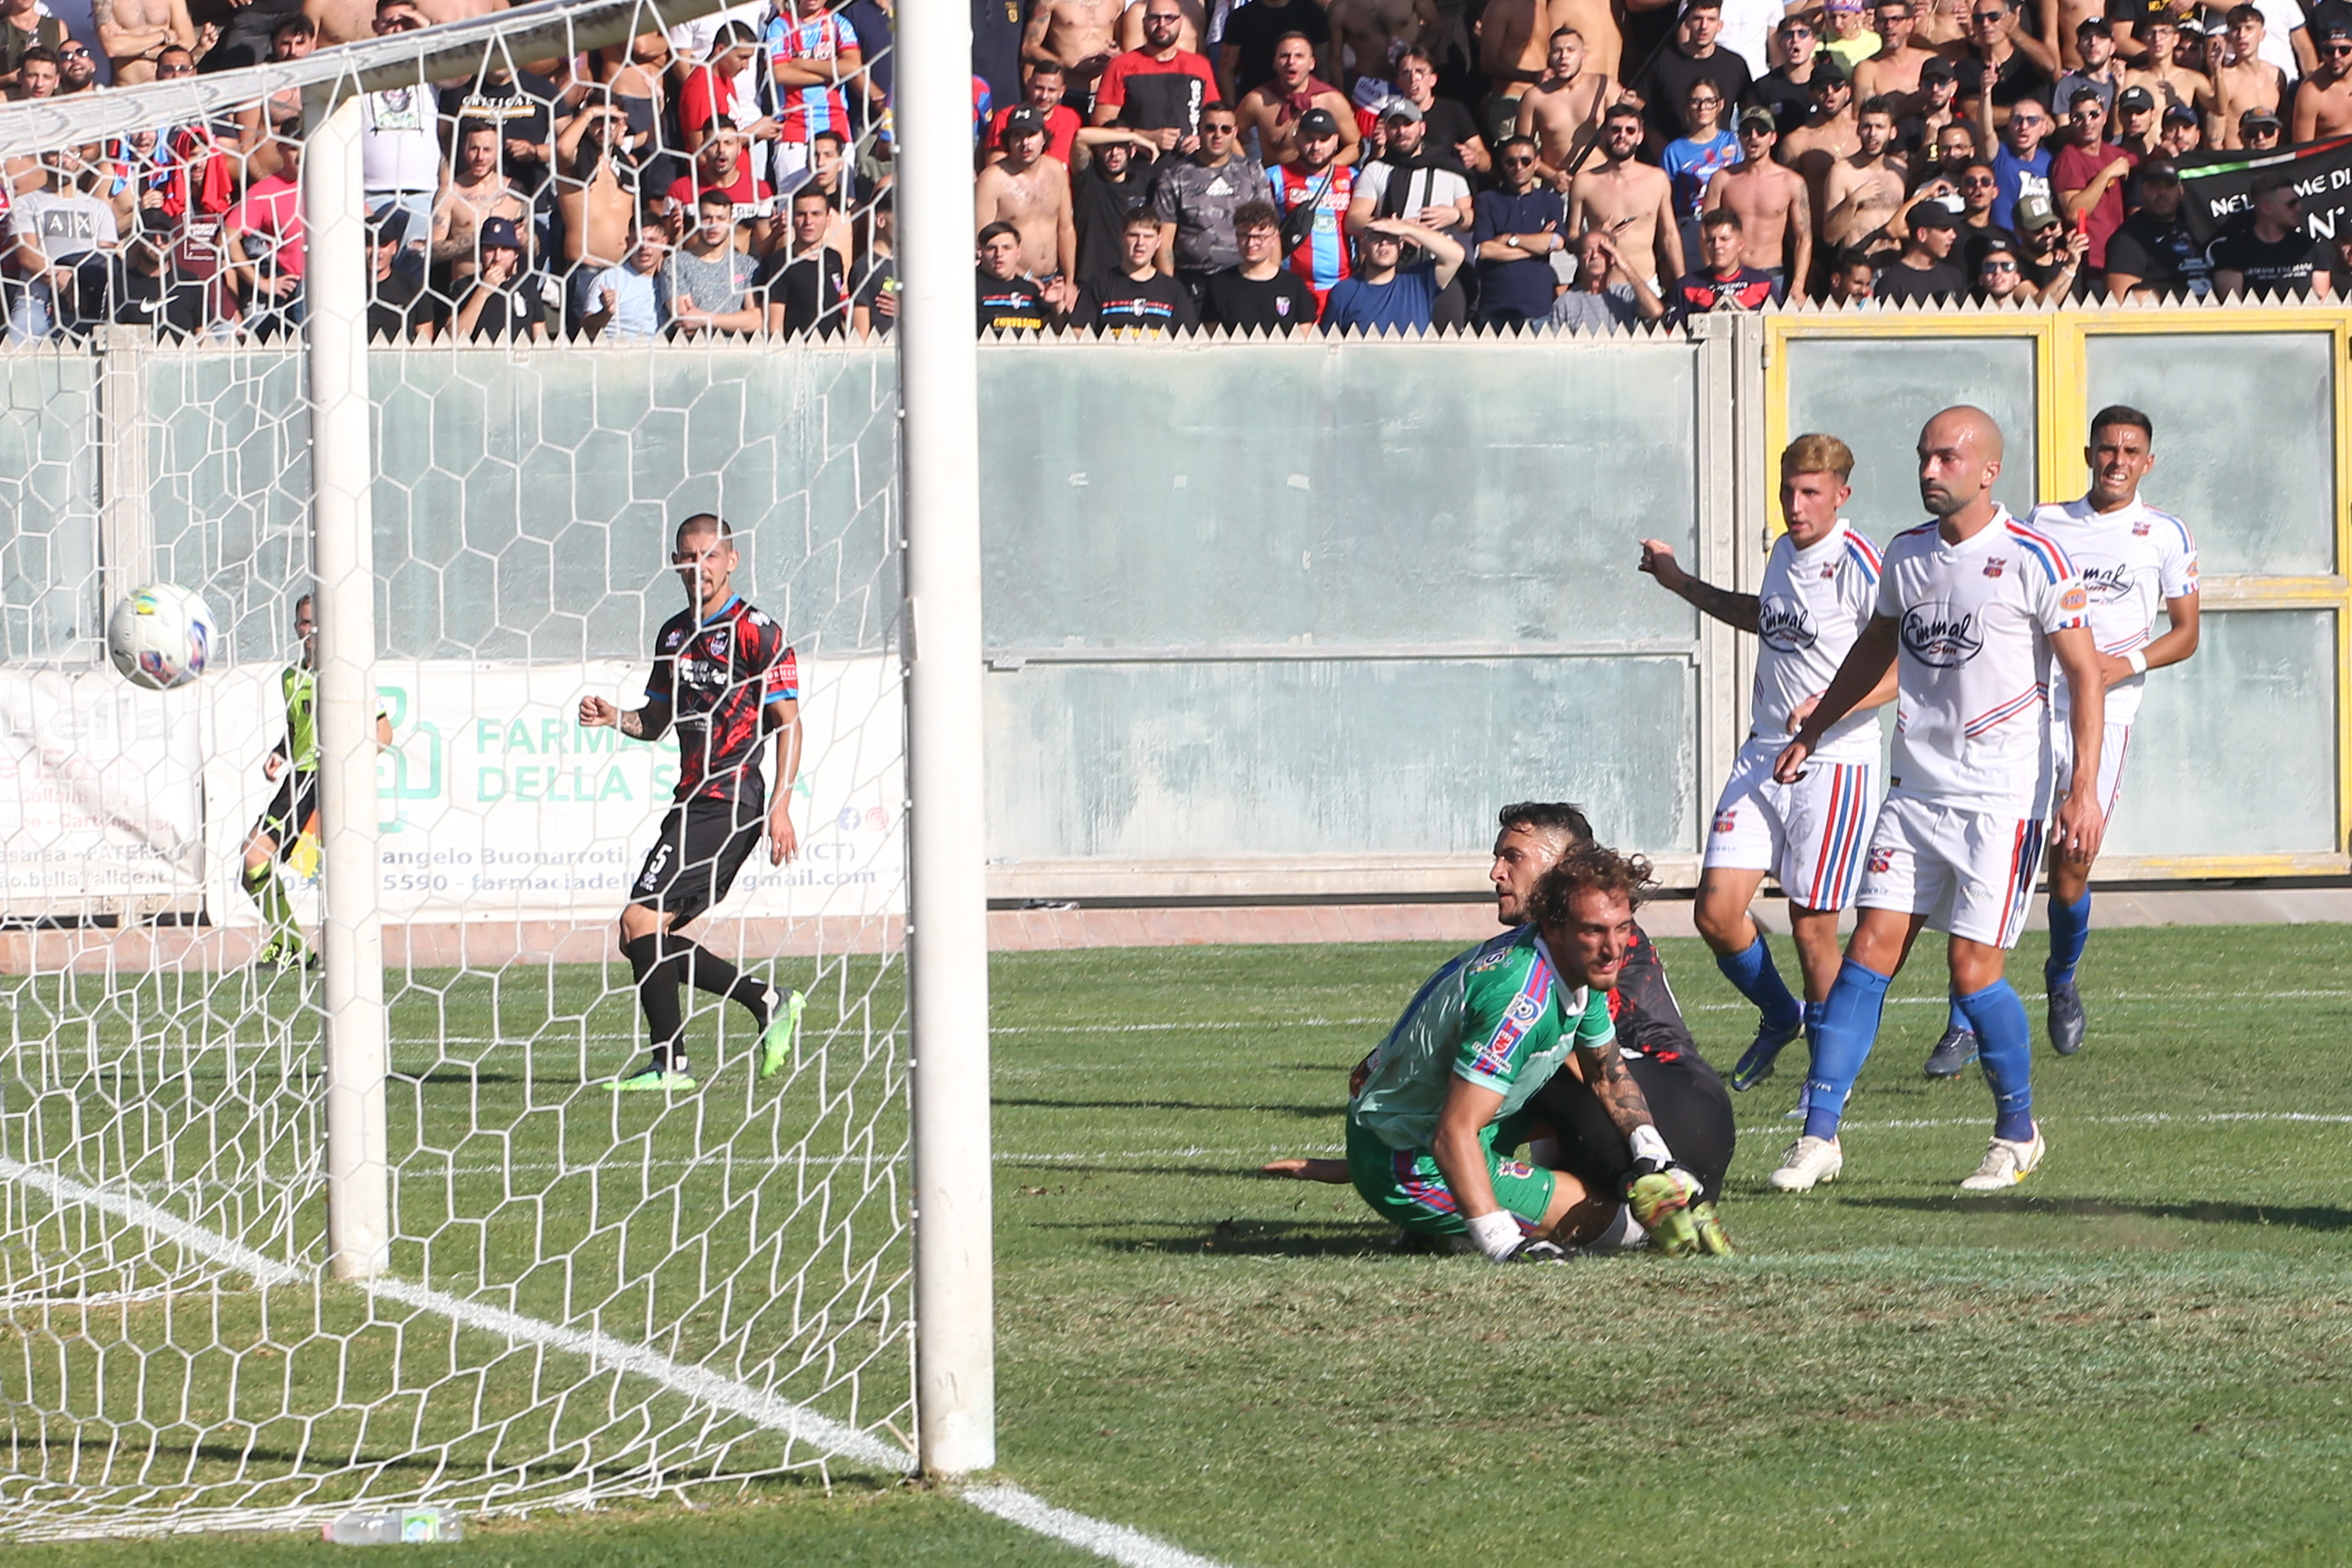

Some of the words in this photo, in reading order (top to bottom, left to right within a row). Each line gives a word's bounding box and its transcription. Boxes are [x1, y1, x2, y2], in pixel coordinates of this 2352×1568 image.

[2209, 193, 2254, 217] NEL
[1907, 613, 1971, 645] Emmal
[1929, 642, 1957, 655] Sun
[477, 766, 634, 802] DELLA
[383, 848, 473, 869] angelo
[806, 843, 855, 863] (CT)
[649, 843, 673, 875] 5
